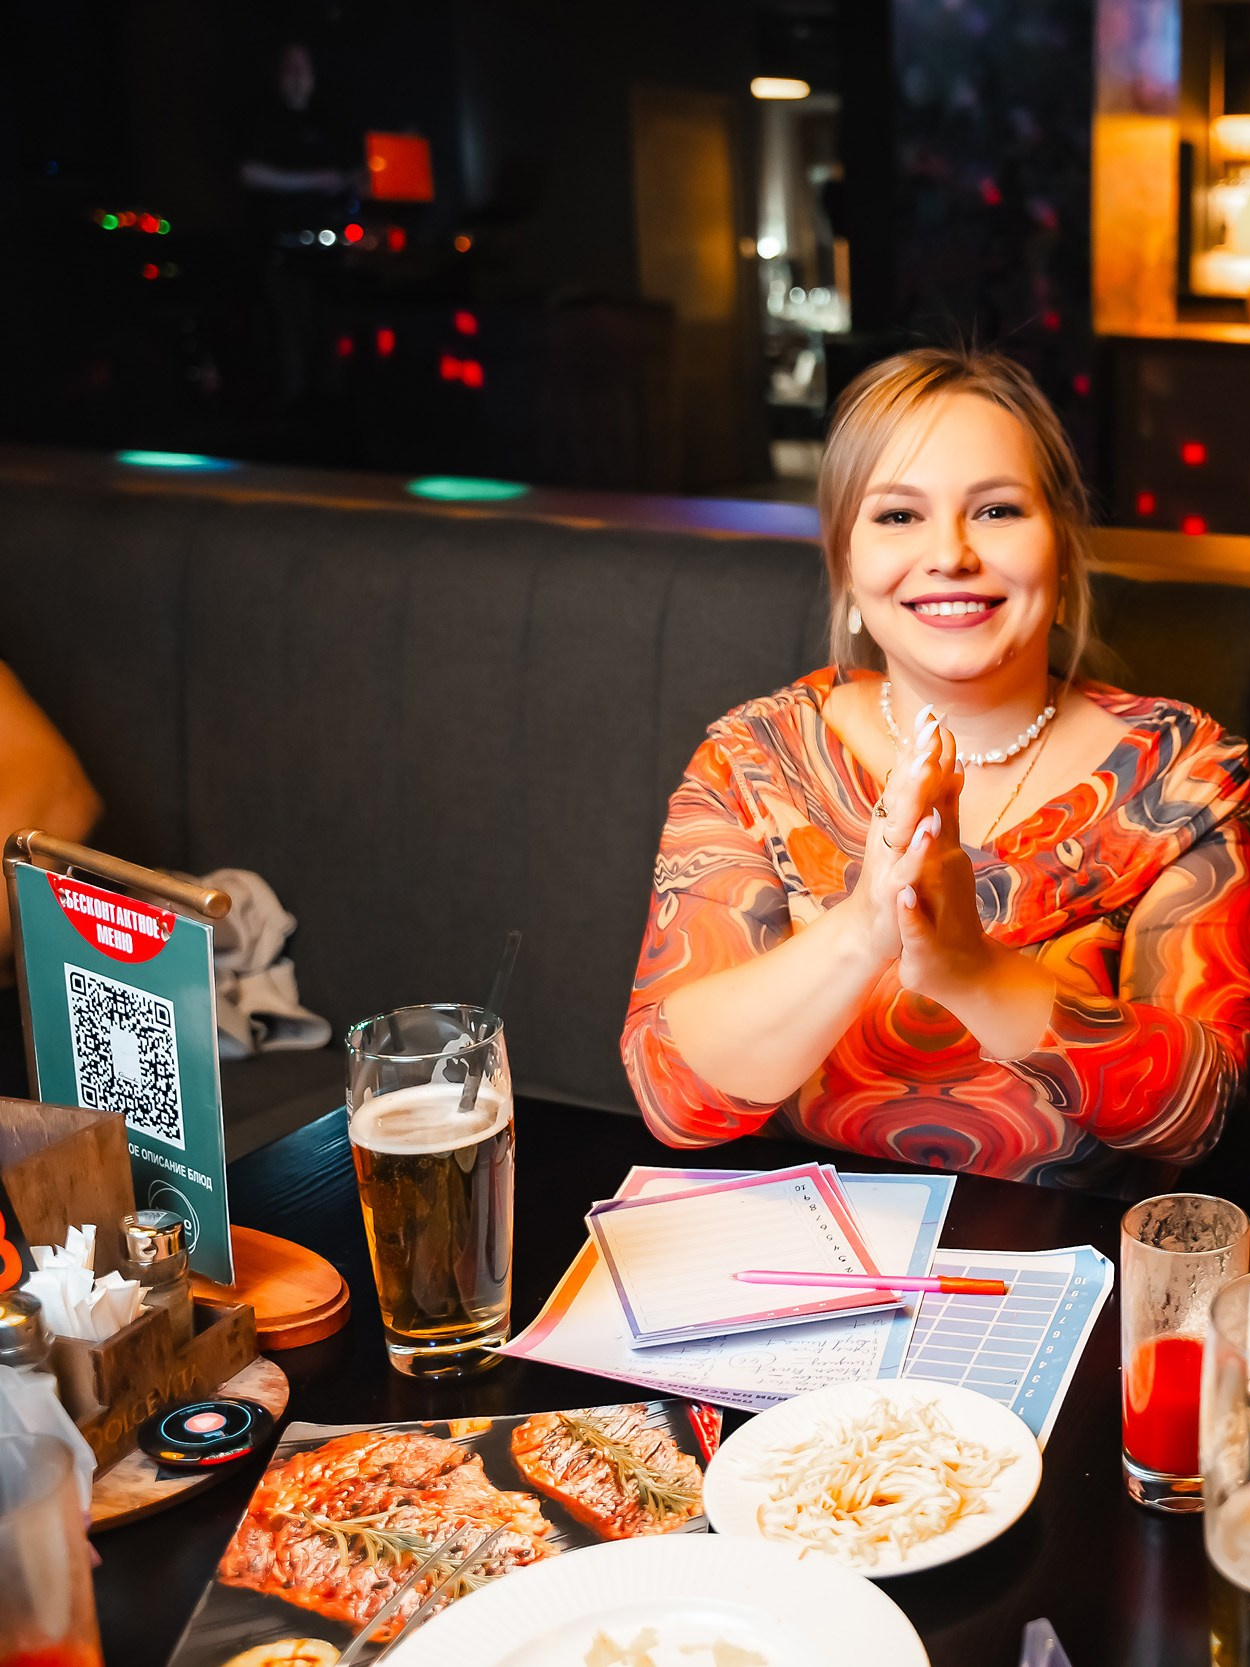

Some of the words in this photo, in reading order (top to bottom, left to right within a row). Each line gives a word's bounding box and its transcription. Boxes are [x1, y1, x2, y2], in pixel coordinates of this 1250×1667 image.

[64, 889, 161, 939] БЕСКОНТАКТНОЕ
[96, 923, 134, 954] МЕНЮ
[128, 1142, 141, 1157] ОЕ
[141, 1148, 187, 1177] ОПИСАНИЕ
[187, 1168, 213, 1192] БЛЮД
[795, 1184, 806, 1192] 10
[1074, 1277, 1088, 1285] 10
[1059, 1316, 1066, 1324] 7
[1052, 1330, 1060, 1338] 6
[1046, 1345, 1054, 1353] 5
[1039, 1360, 1047, 1368] 4
[1032, 1374, 1041, 1383] 3
[732, 1391, 753, 1399] НА
[1025, 1389, 1034, 1397] 2
[754, 1394, 789, 1402] ИЛИ
[1019, 1407, 1025, 1415] 1
